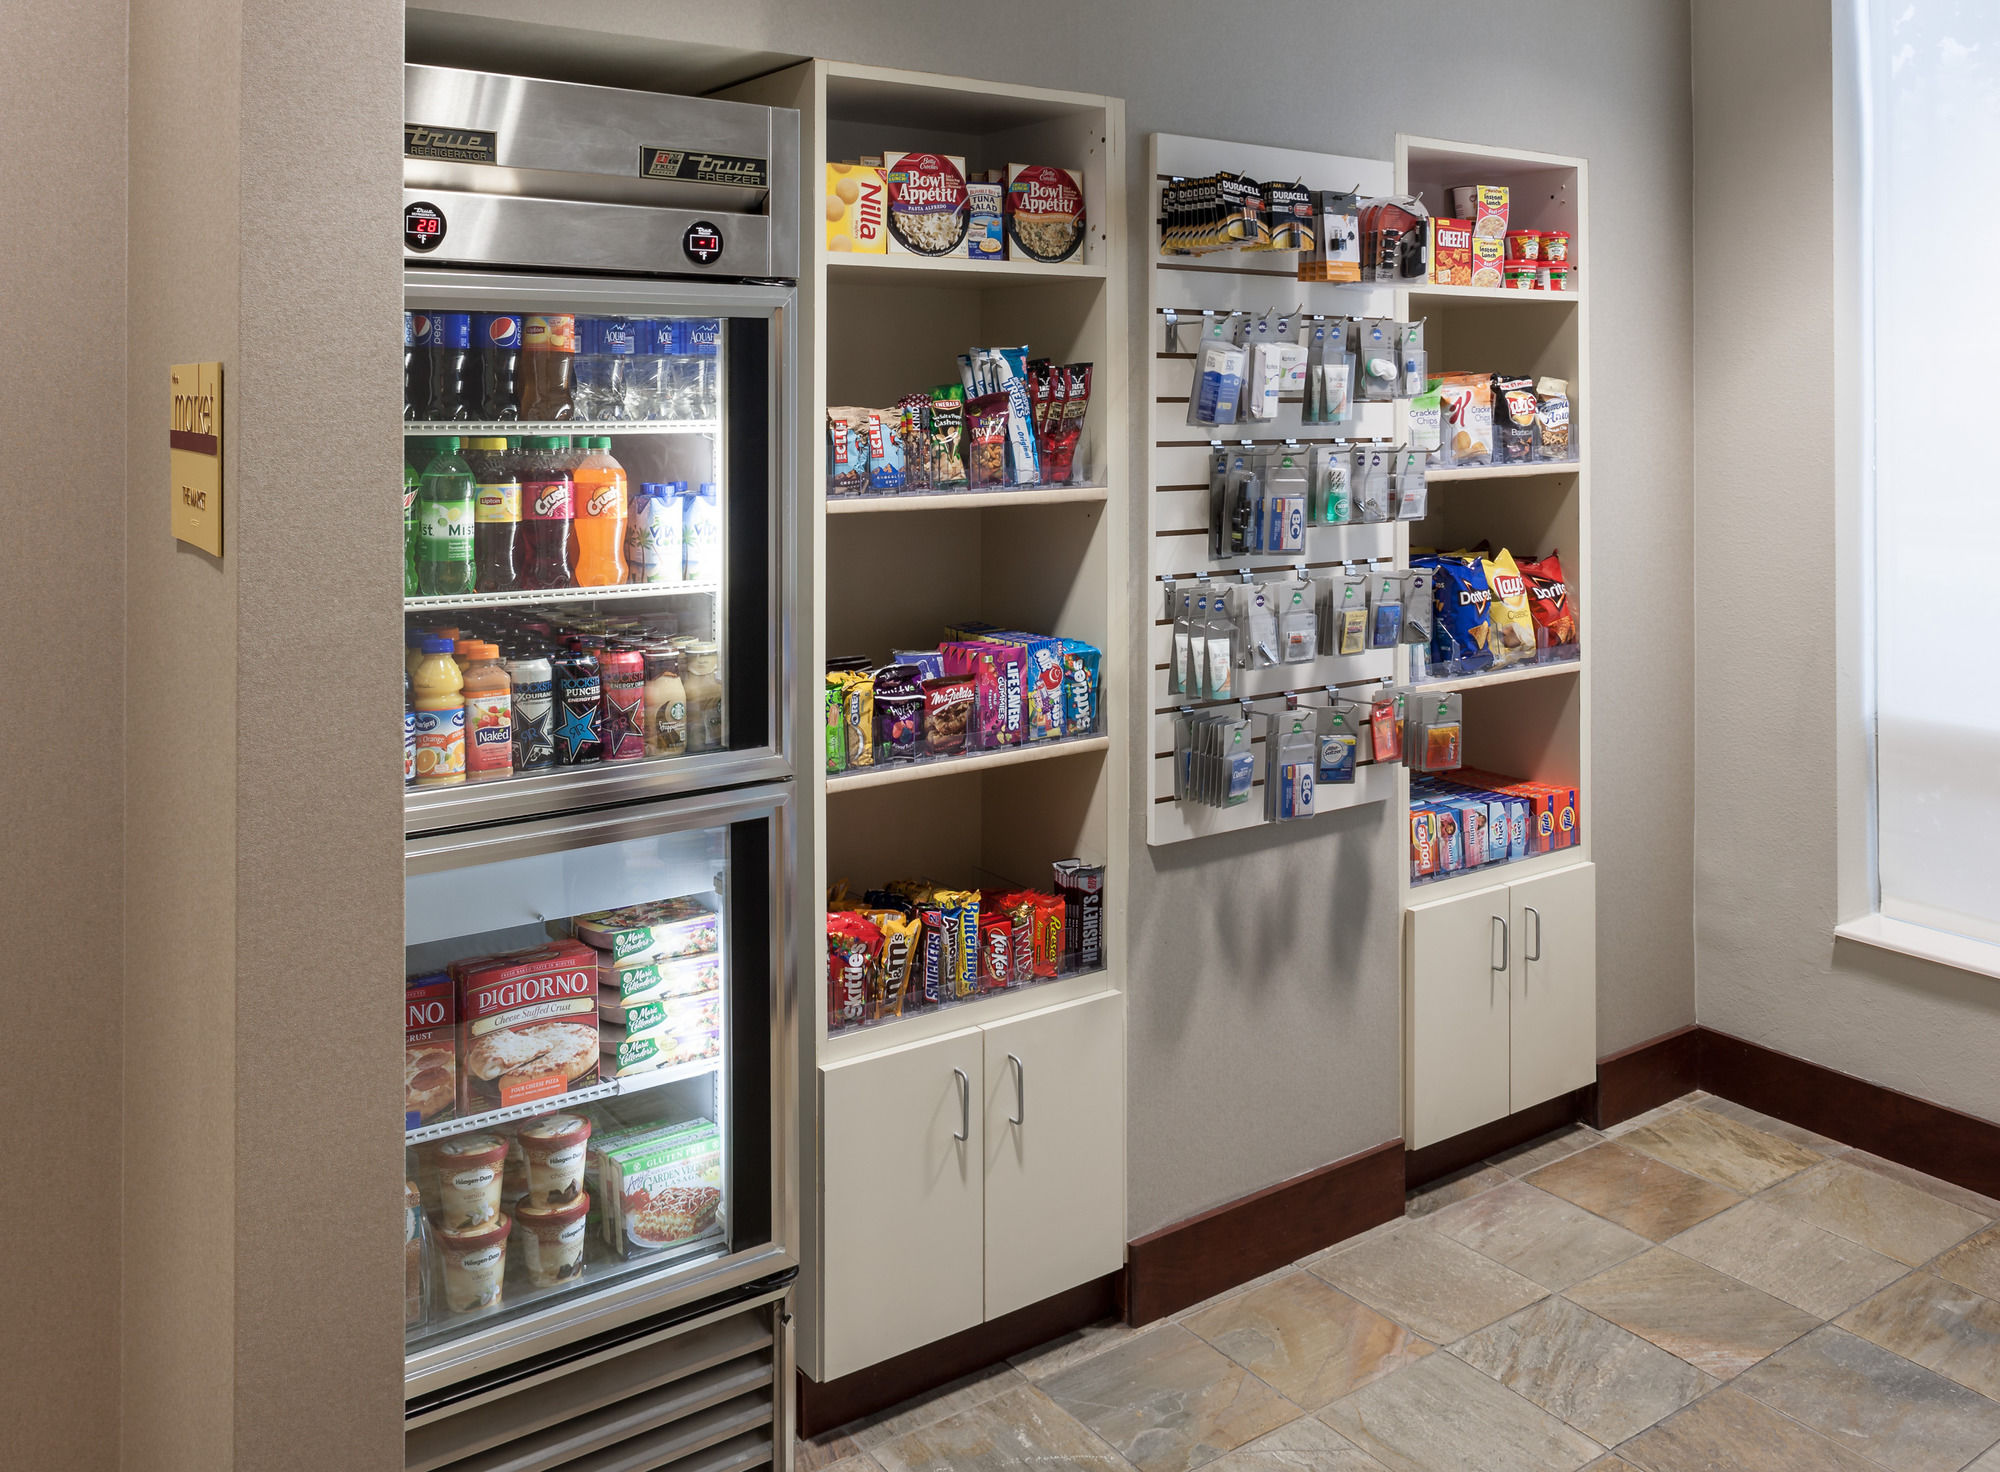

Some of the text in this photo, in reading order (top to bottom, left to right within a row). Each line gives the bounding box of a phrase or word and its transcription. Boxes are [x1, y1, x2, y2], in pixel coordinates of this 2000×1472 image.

[411, 147, 487, 160] REFRIGERATOR
[697, 172, 760, 184] FREEZER
[907, 170, 946, 188] Bowl
[1222, 180, 1260, 196] DURACELL
[897, 183, 957, 205] Appétit!
[973, 195, 995, 205] TUNA
[1029, 181, 1063, 200] Bowl
[1272, 190, 1309, 201] DURACELL
[1484, 193, 1503, 201] Instant
[860, 182, 882, 240] Nilla
[924, 203, 947, 211] ALFREDO
[970, 204, 998, 212] SALAD
[1019, 193, 1074, 213] Appétit!
[416, 218, 438, 232] 28
[1437, 229, 1471, 249] CHEEZ-IT
[1479, 246, 1498, 254] Instant
[433, 316, 442, 344] pepsi
[174, 364, 214, 435] market
[933, 400, 960, 408] EMERALD
[1002, 379, 1026, 419] TREATS
[912, 407, 921, 431] KIND
[1416, 417, 1438, 425] Chips
[869, 416, 882, 450] CLIF
[1017, 431, 1031, 459] Original
[480, 497, 502, 505] Lipton
[535, 485, 568, 516] Crush
[1291, 511, 1301, 536] BC
[610, 681, 635, 689] ENERGY
[946, 686, 974, 703] Fields
[997, 676, 1007, 720] GUMMIES
[851, 692, 861, 726] OREO
[423, 735, 445, 744] Orange
[479, 730, 509, 742] Naked
[1541, 813, 1550, 836] Tide
[1563, 809, 1571, 830] Tide
[1494, 818, 1504, 846] cheer
[1513, 818, 1523, 845] cheer
[1417, 825, 1432, 869] bounce
[626, 931, 646, 944] Marie
[1083, 894, 1099, 963] HERSHEY'S
[944, 916, 959, 979] Almond
[962, 902, 981, 991] Butterfinge
[1011, 915, 1033, 976] TWIX
[633, 969, 653, 982] Marie
[926, 933, 940, 1000] SNICKERS
[494, 1003, 572, 1027] Cheese Stuffed Crust
[638, 1006, 658, 1019] Marie
[630, 1040, 649, 1053] Marie
[524, 1082, 545, 1090] CHEESE
[545, 1078, 560, 1086] PIZZA
[646, 1152, 682, 1167] GLUTEN
[643, 1168, 681, 1192] GARDEN
